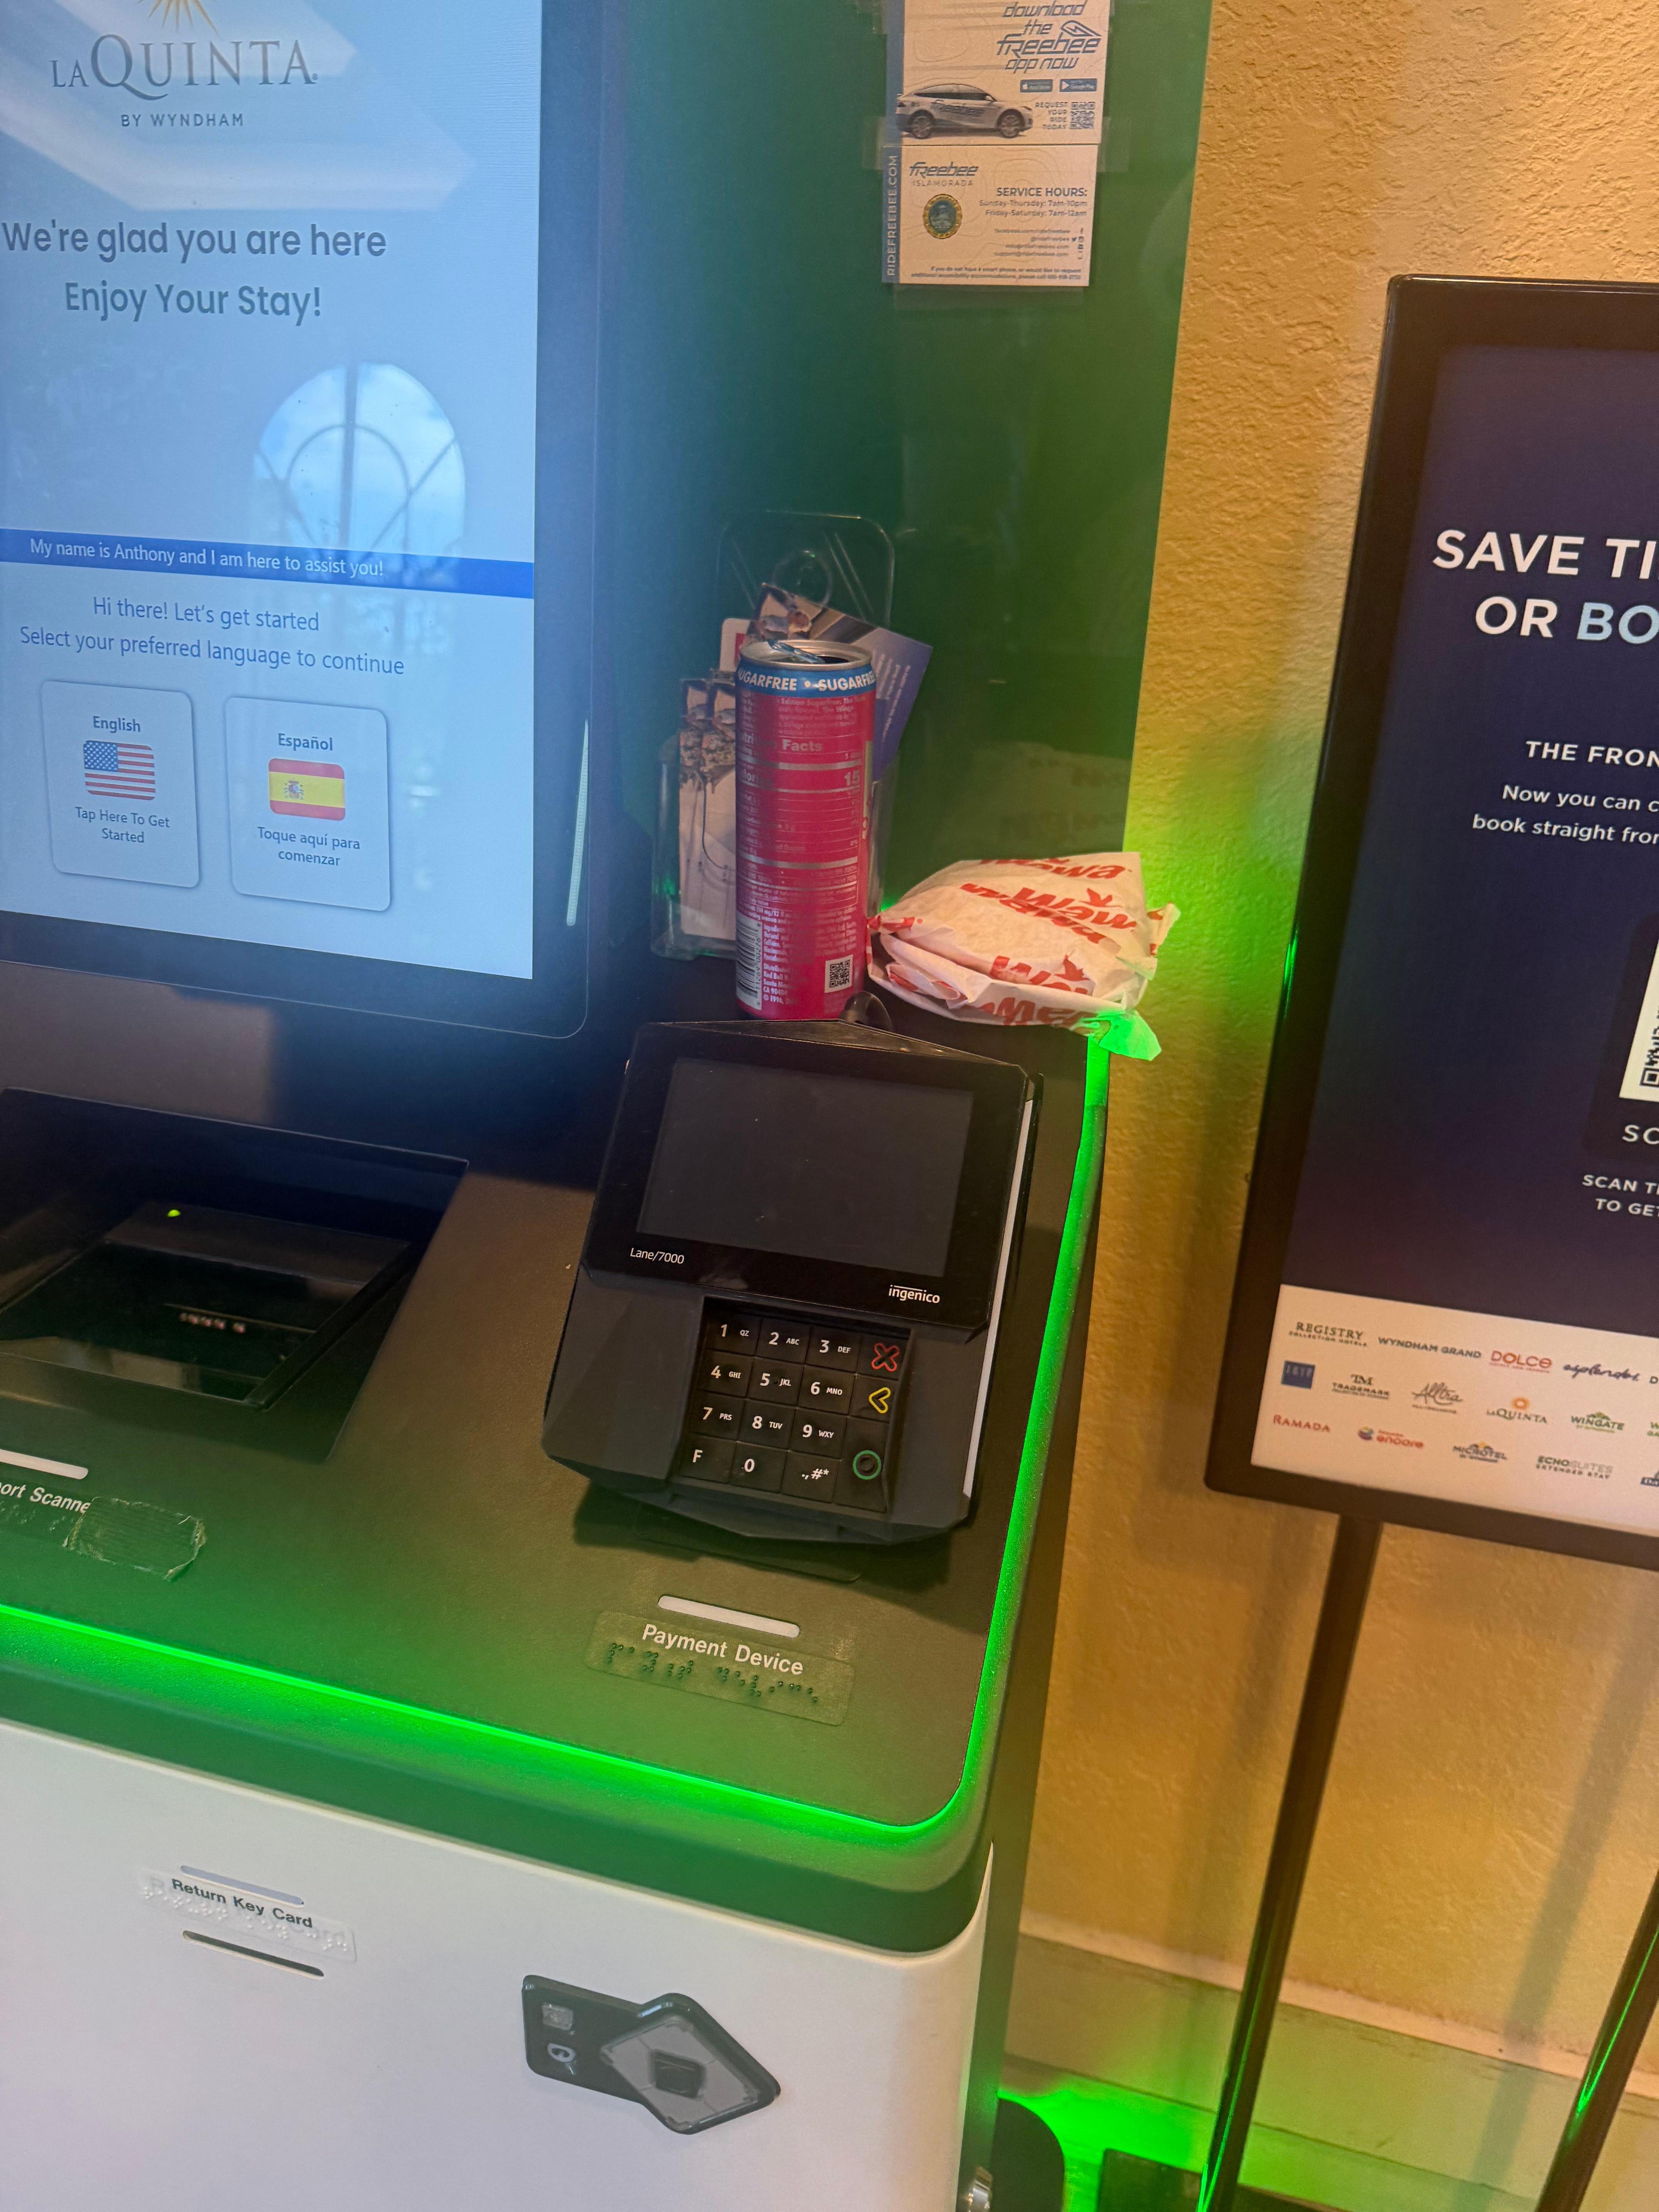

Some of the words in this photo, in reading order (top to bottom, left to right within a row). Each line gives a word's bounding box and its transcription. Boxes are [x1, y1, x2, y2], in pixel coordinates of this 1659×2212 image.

[1003, 0, 1089, 17] download
[1023, 19, 1053, 35] the
[996, 31, 1102, 58] freebee
[91, 34, 316, 100] QUINTA
[1004, 58, 1039, 74] app
[1039, 57, 1079, 69] now
[120, 114, 142, 127] BY
[150, 113, 244, 127] WYNDHAM
[909, 161, 979, 179] freebee
[996, 187, 1042, 197] SERVICE
[1045, 187, 1088, 197] HOURS:
[2, 218, 89, 252] We're
[98, 222, 168, 263] glad
[176, 229, 236, 264] you
[246, 228, 301, 256] are
[311, 223, 386, 257] here
[65, 279, 147, 322] Enjoy
[155, 283, 229, 314] Your
[238, 285, 321, 326] Stay!
[30, 538, 53, 558] My
[56, 544, 96, 558] name
[99, 543, 111, 559] is
[114, 544, 175, 566] Anthony
[179, 548, 206, 565] and
[211, 550, 216, 565] I
[220, 553, 243, 568] am
[247, 551, 281, 570] here
[285, 556, 301, 571] to
[305, 556, 347, 575] assist
[349, 560, 384, 578] you!
[1432, 529, 1585, 575] SAVE
[1605, 538, 1659, 580] TI
[93, 596, 112, 616] Hi
[117, 598, 168, 620] there!
[175, 602, 215, 624] Let's
[221, 608, 250, 630] get
[255, 610, 319, 632] started
[1475, 596, 1558, 638] OR
[1577, 602, 1659, 644] BO
[20, 626, 71, 648] Select
[75, 635, 114, 653] your
[120, 633, 202, 659] preferred
[207, 641, 291, 669] language
[297, 650, 316, 668] to
[322, 653, 405, 675] continue
[738, 668, 797, 691] UGARFREE
[93, 716, 141, 734] English
[277, 733, 334, 752] Español
[1525, 740, 1578, 761] THE
[1502, 785, 1550, 804] Now
[1556, 792, 1596, 808] you
[1602, 796, 1641, 811] can
[75, 807, 96, 822] Tap
[99, 809, 128, 825] Here
[131, 812, 146, 826] To
[148, 814, 170, 829] Get
[101, 828, 145, 844] Started
[1472, 814, 1527, 834] book
[1531, 821, 1616, 842] straight
[257, 826, 297, 845] Toque
[300, 832, 328, 850] aquí
[332, 837, 361, 850] para
[278, 849, 341, 867] comenzar
[1582, 1174, 1638, 1192] SCAN
[1595, 1198, 1621, 1212] TO
[629, 1247, 685, 1265] Lane/7000
[888, 1284, 941, 1304] ingenico
[720, 1324, 728, 1338] 1
[739, 1329, 750, 1338] QZ
[768, 1332, 779, 1346] 2
[786, 1337, 800, 1346] ABC
[1296, 1321, 1364, 1340] REGISTRY
[819, 1339, 830, 1353] 3
[837, 1345, 851, 1354] DEF
[1378, 1336, 1438, 1352] WYNDHAM
[1441, 1346, 1482, 1358] GRAND
[710, 1365, 721, 1379] 4
[728, 1371, 742, 1379] GHI
[759, 1372, 770, 1387] 5
[778, 1378, 792, 1387] JKL
[810, 1381, 821, 1395] 6
[826, 1387, 843, 1396] MNO
[702, 1407, 713, 1421] 7
[719, 1413, 733, 1421] PRS
[751, 1415, 763, 1429] 8
[769, 1421, 783, 1430] TUV
[1273, 1414, 1331, 1432] RAMADA
[1571, 1415, 1625, 1431] WINGATE
[802, 1424, 813, 1438] 9
[818, 1430, 835, 1438] WXY
[692, 1449, 703, 1464] F
[744, 1458, 755, 1472] 0
[0, 1482, 27, 1498] ort
[642, 1623, 728, 1658] Payment
[734, 1644, 804, 1675] Device
[172, 1878, 227, 1904] Return
[232, 1896, 265, 1916] Key
[272, 1907, 313, 1928] Card
